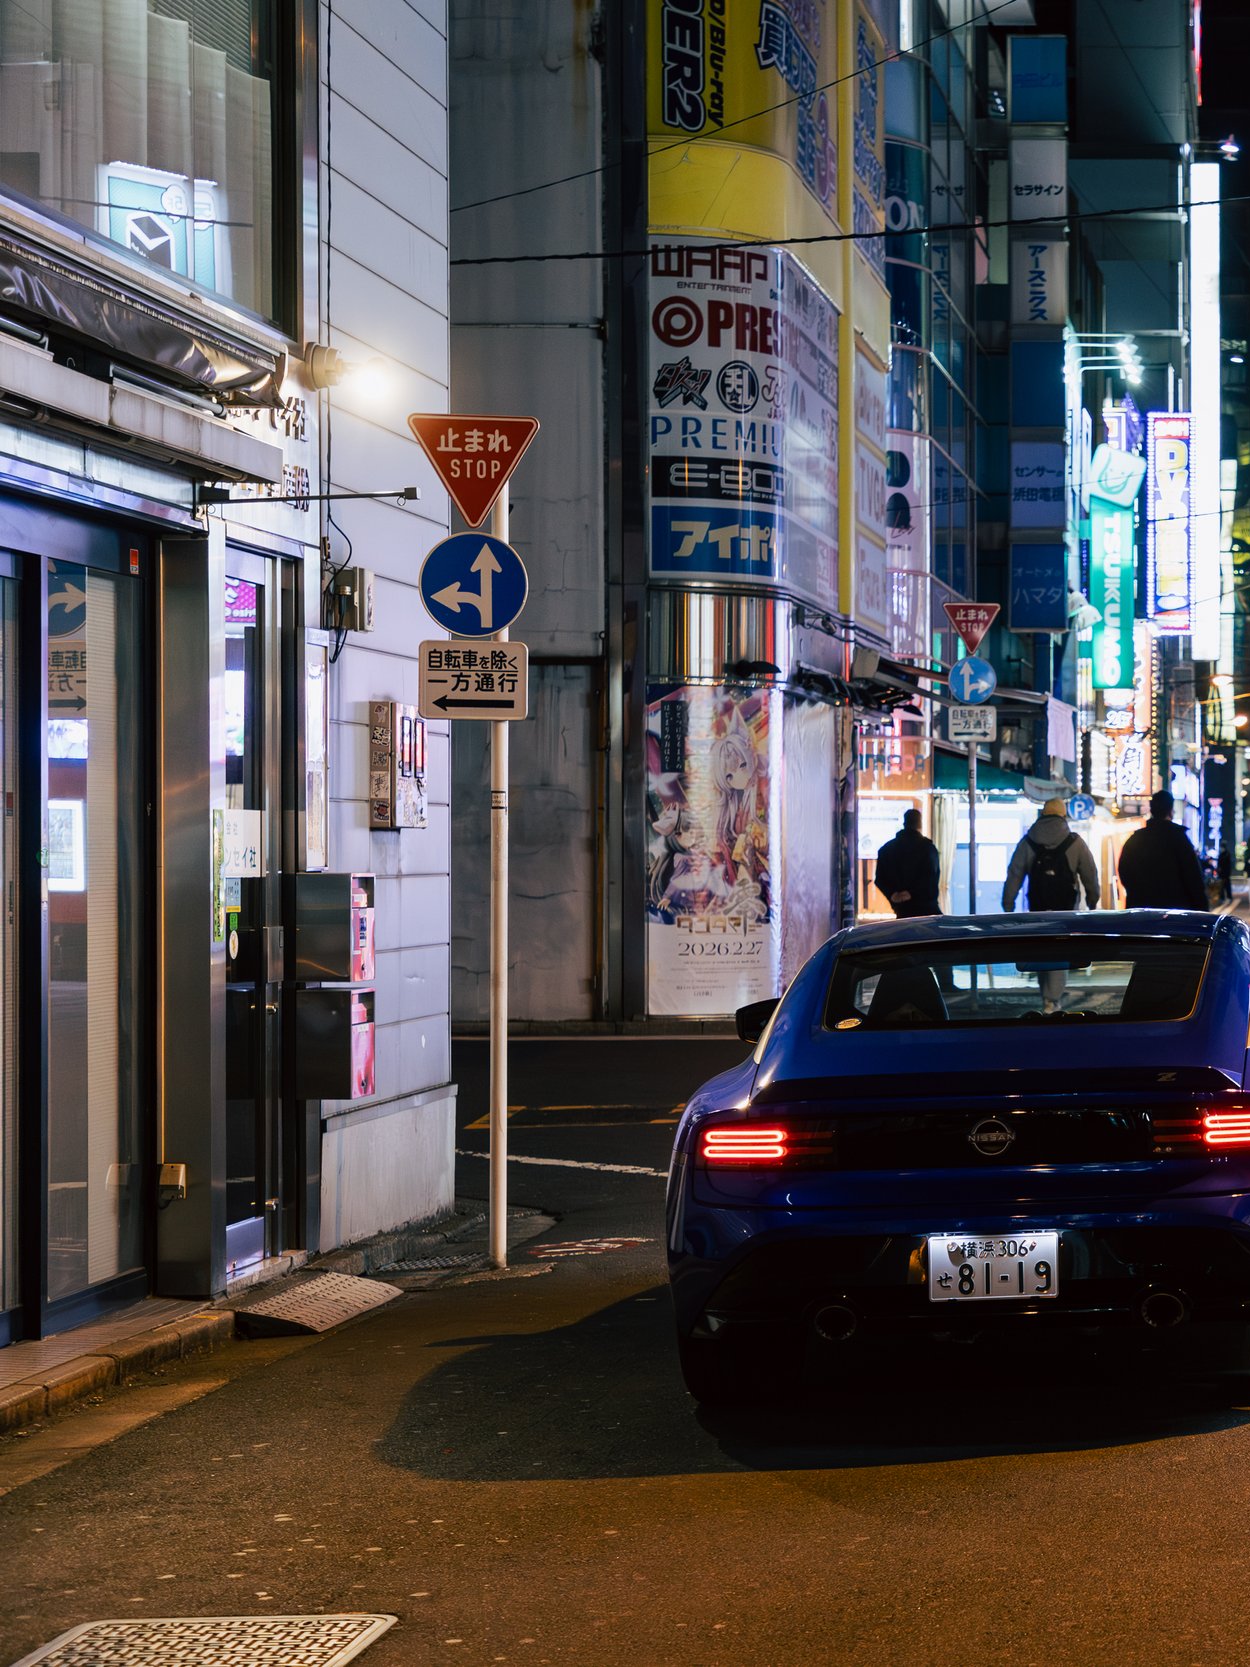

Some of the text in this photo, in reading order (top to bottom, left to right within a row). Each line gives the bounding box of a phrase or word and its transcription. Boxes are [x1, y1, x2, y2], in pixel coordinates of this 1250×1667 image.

[1013, 184, 1064, 197] セラサイン
[1028, 245, 1048, 321] アースニクス
[436, 427, 512, 453] 止まれ
[450, 458, 501, 480] STOP
[1103, 512, 1121, 686] TSUKUMO
[955, 610, 989, 622] 止まれ
[961, 622, 984, 633] STOP
[428, 648, 518, 670] 自転車を除く
[427, 672, 519, 693] 一方通行
[678, 940, 764, 957] 2026.2.27
[1156, 1072, 1177, 1082] Z
[968, 1133, 1014, 1143] NISSAN
[960, 1240, 1029, 1258] 横浜 306
[937, 1261, 1051, 1295] せ 81-19
